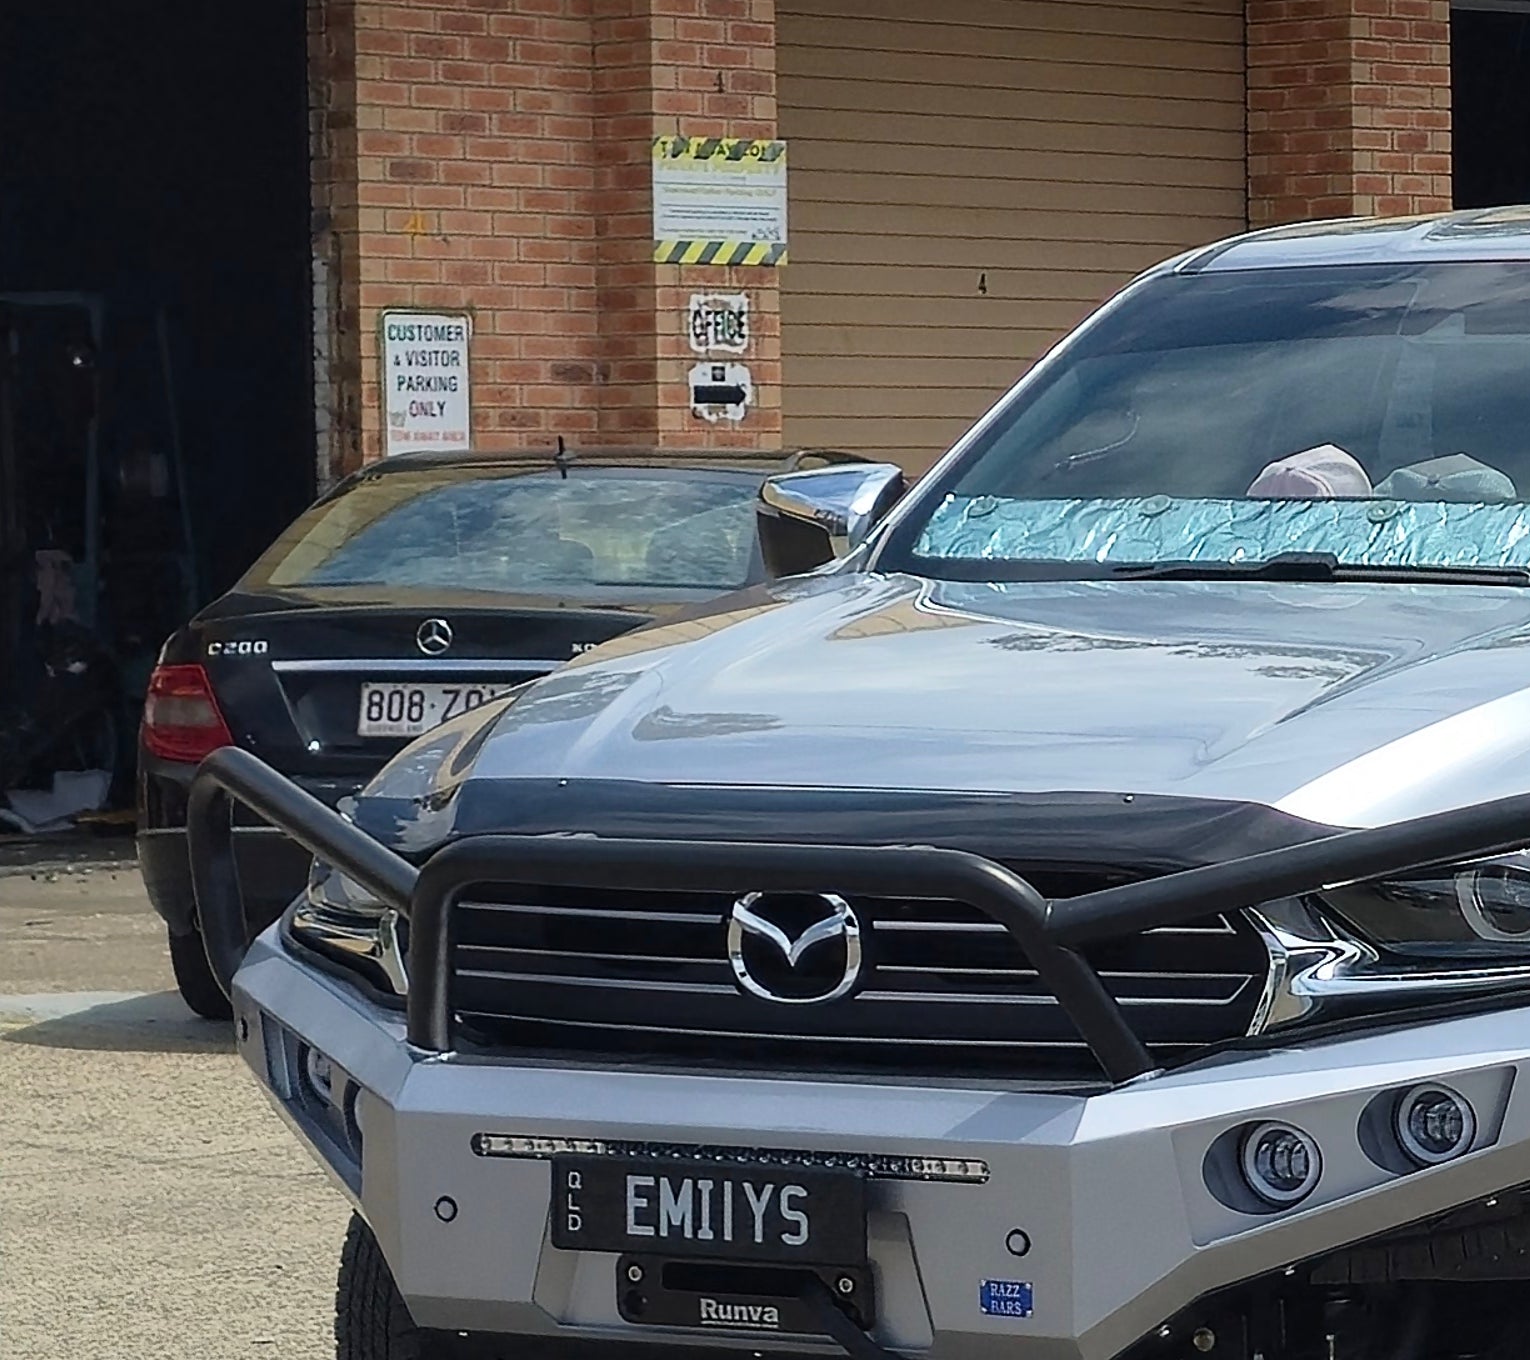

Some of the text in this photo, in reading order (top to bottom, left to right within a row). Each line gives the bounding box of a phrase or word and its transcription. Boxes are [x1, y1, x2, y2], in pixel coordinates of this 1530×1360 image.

[387, 324, 465, 342] CUSTOMER
[405, 350, 461, 367] VISITOR
[396, 375, 459, 392] PARKING
[408, 400, 446, 417] ONLY
[208, 641, 269, 656] C200
[568, 1172, 582, 1231] QLD
[990, 1283, 1020, 1297] RAZZ
[701, 1298, 780, 1328] Runva
[991, 1300, 1022, 1315] BARS
